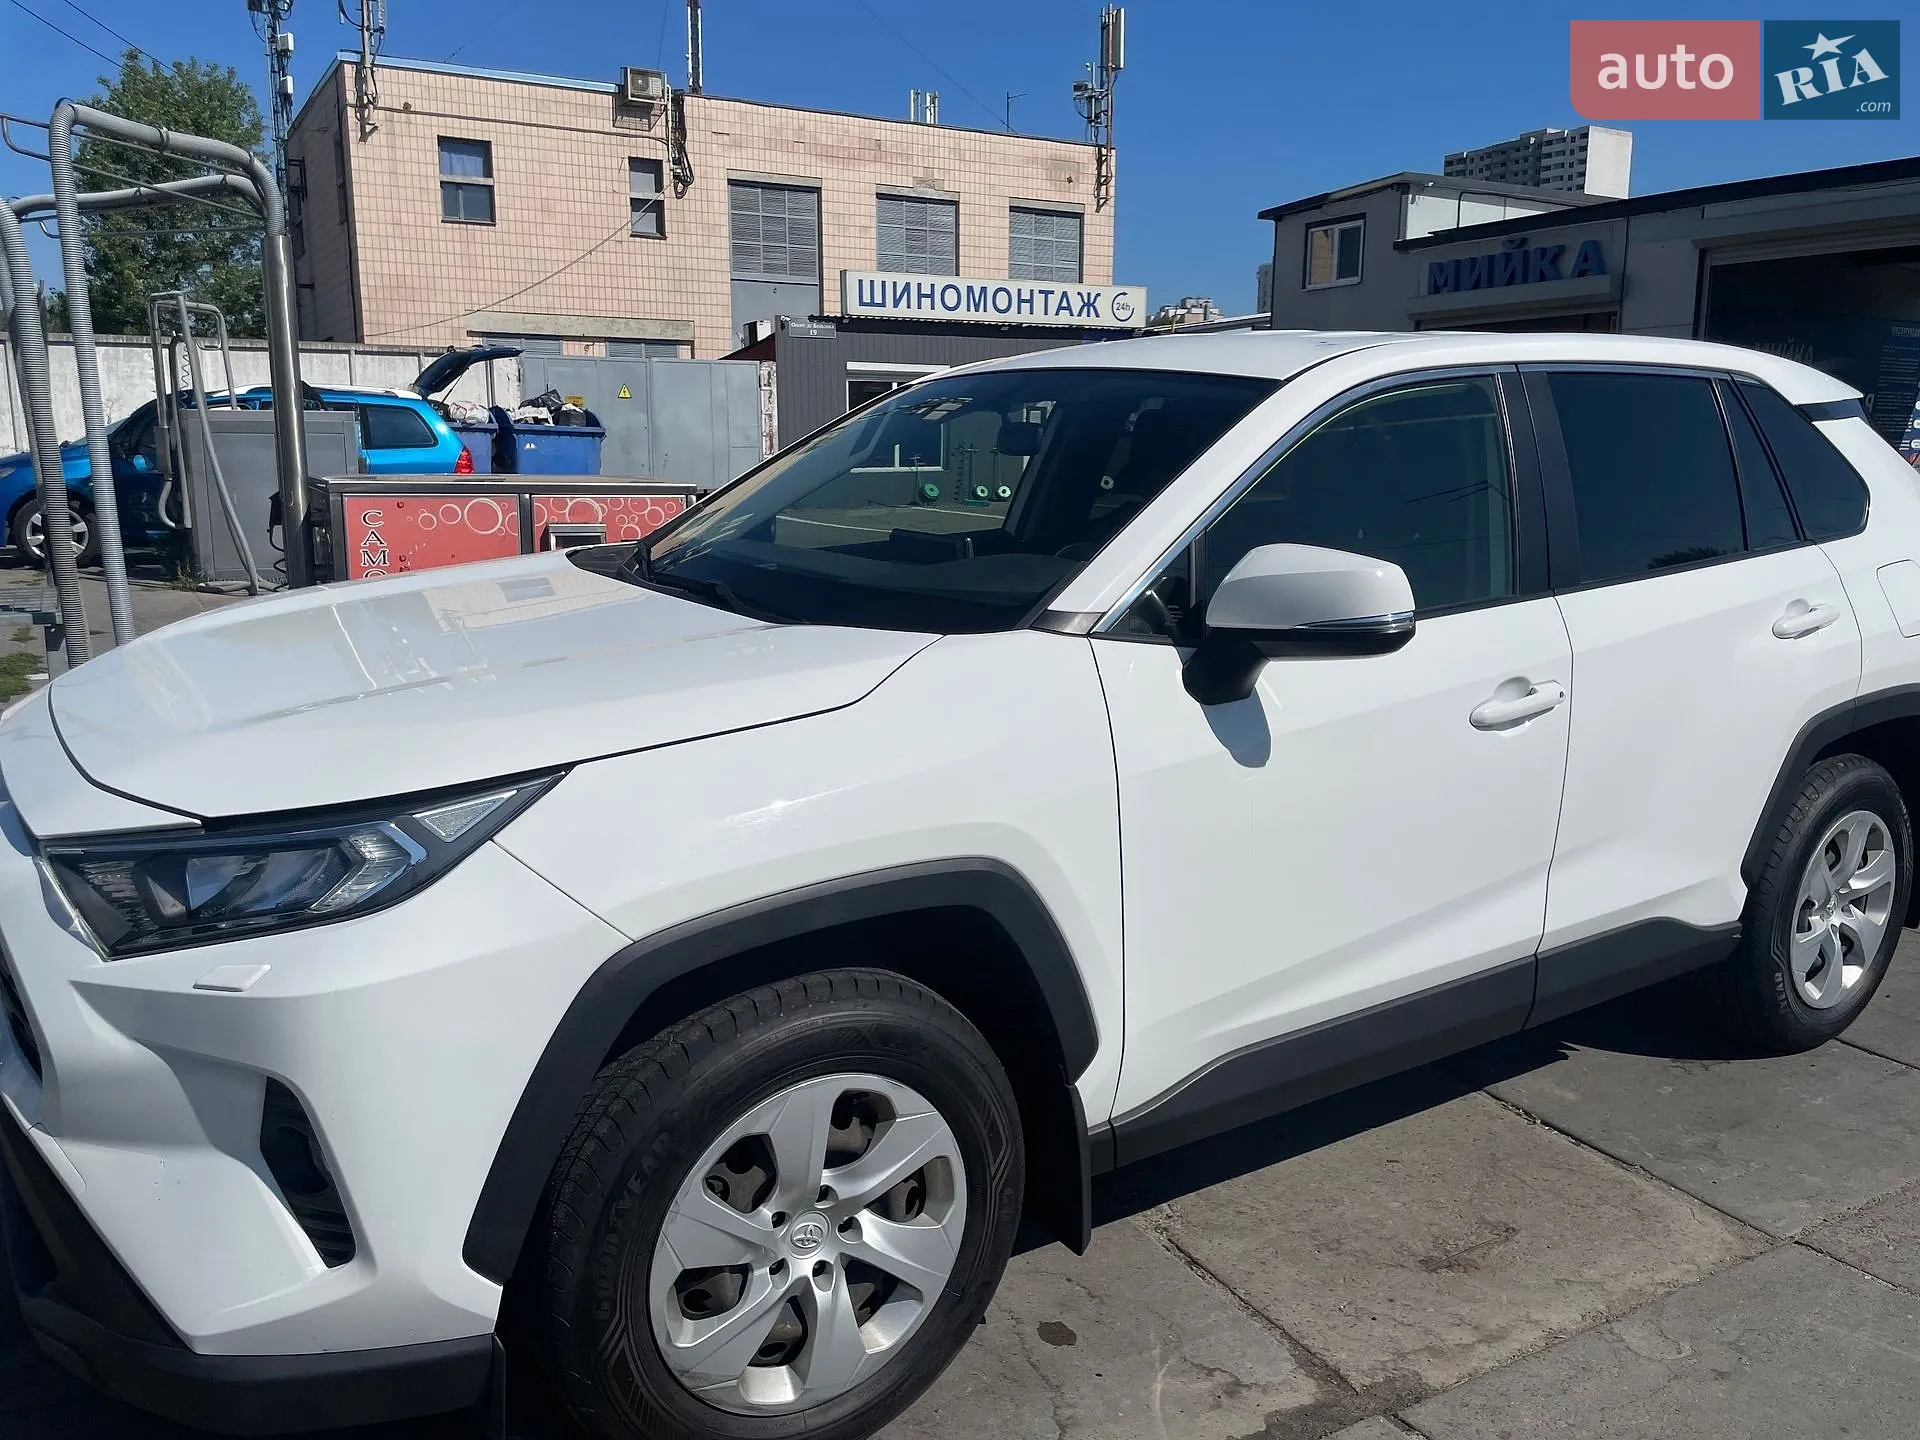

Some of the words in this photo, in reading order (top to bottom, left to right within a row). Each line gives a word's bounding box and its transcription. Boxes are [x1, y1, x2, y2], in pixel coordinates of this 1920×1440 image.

[1427, 237, 1609, 296] МИЙКА
[857, 277, 1102, 319] ШИНОМОНТАЖ
[1114, 300, 1131, 313] 24h
